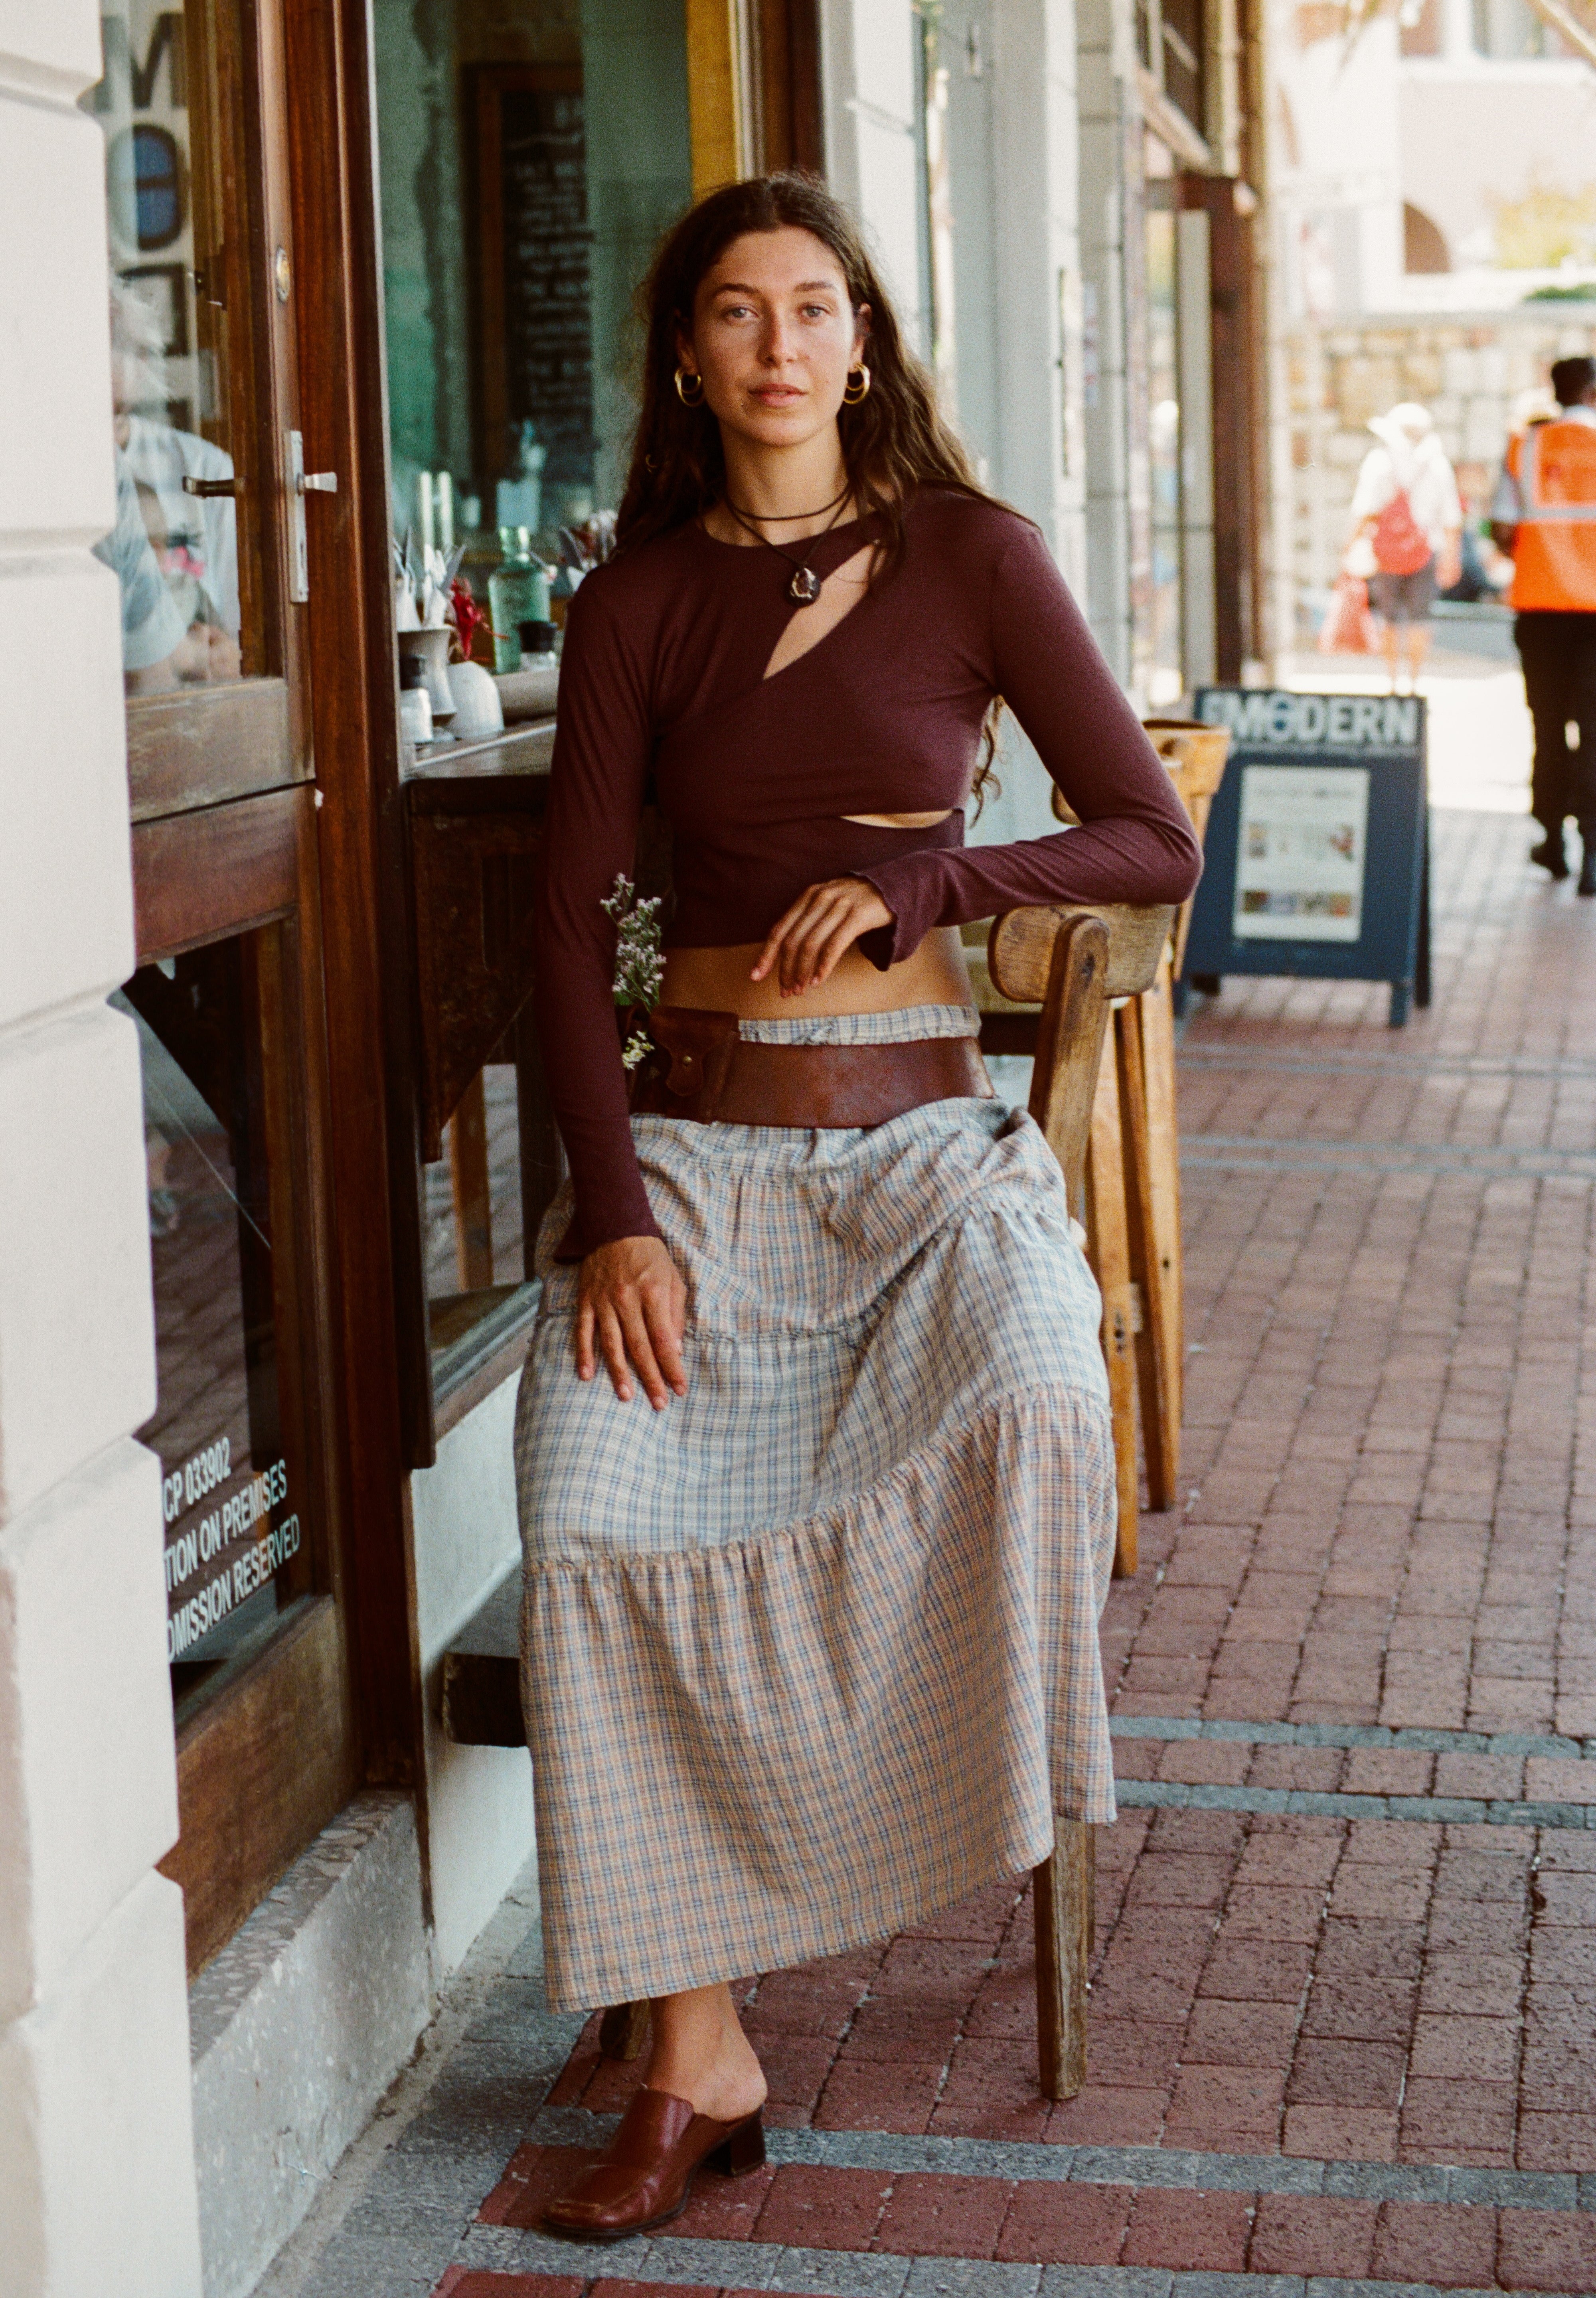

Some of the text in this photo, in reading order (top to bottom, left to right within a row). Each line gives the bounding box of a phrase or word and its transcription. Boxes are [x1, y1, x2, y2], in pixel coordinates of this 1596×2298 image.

[185, 1436, 231, 1505] 033902
[200, 1510, 221, 1562] ON
[223, 1459, 287, 1545] PREMISES
[233, 1514, 300, 1604] RESERVED
